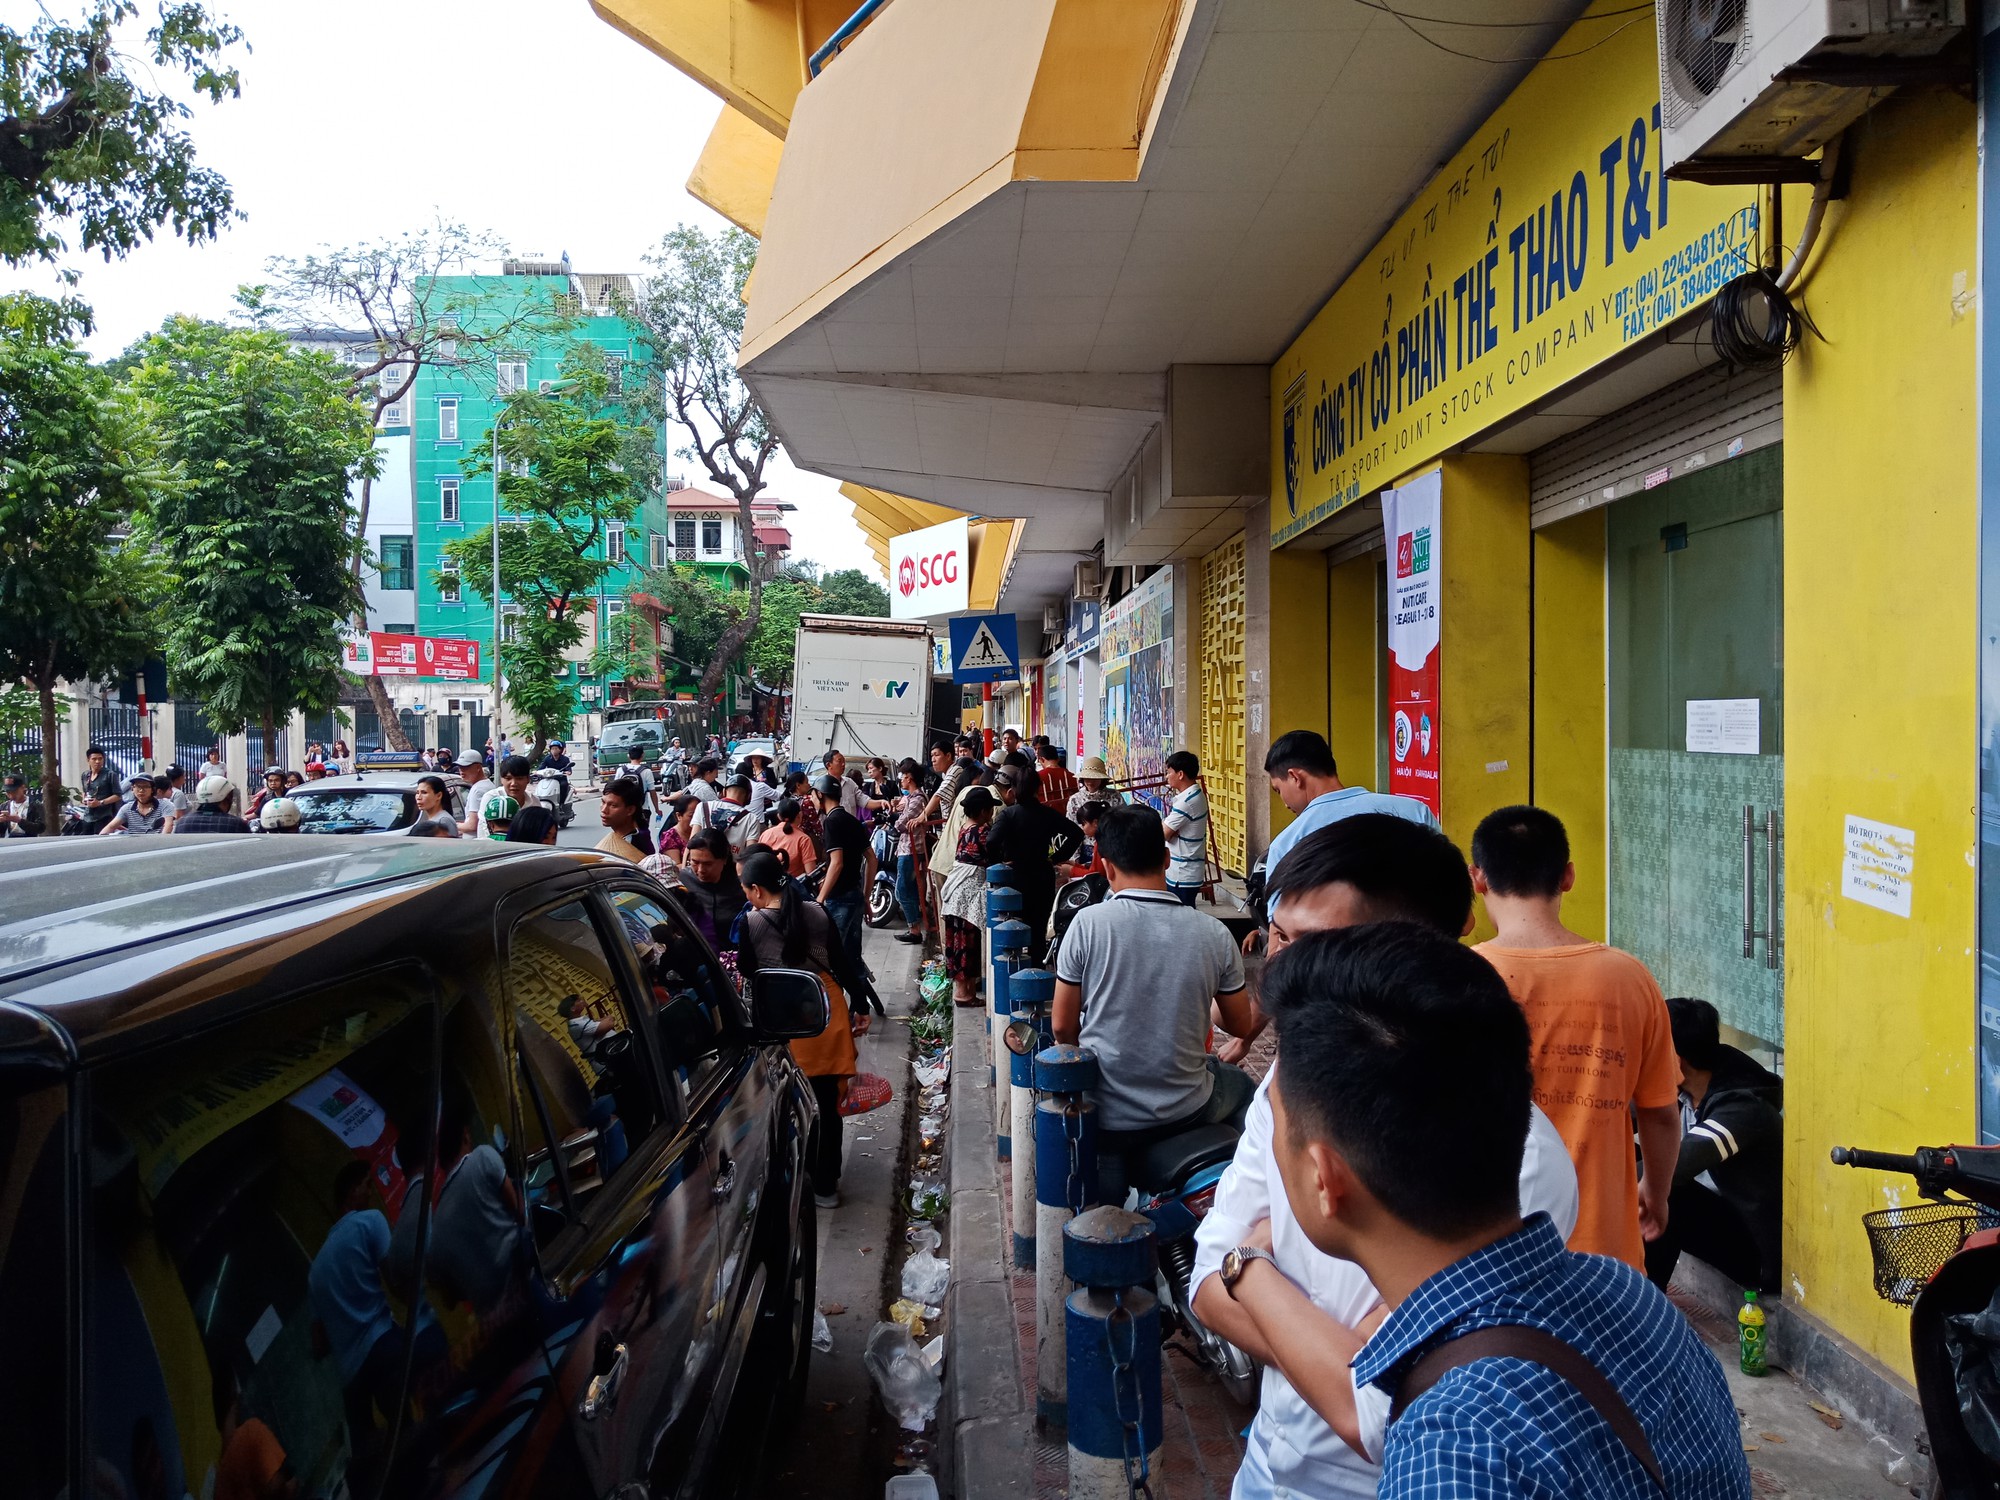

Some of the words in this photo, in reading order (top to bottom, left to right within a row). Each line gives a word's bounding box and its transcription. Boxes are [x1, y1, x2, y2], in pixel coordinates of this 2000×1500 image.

[1448, 164, 1475, 215] THE
[1635, 267, 1659, 308] (04)
[1653, 287, 1677, 328] (04)
[1680, 241, 1748, 309] 38489255
[1312, 379, 1345, 474] CÔNG
[1348, 361, 1367, 448] TY
[1371, 293, 1393, 432] CỔ
[1397, 262, 1447, 414] PHẦN
[1453, 186, 1502, 372] THỂ
[1508, 170, 1588, 334] THAO
[1330, 469, 1346, 495] T&T
[1352, 442, 1386, 482] SPORT
[1394, 412, 1432, 454] JOINT
[1441, 372, 1495, 425] STOCK
[1506, 292, 1613, 386] COMPANY
[919, 550, 958, 589] SCG
